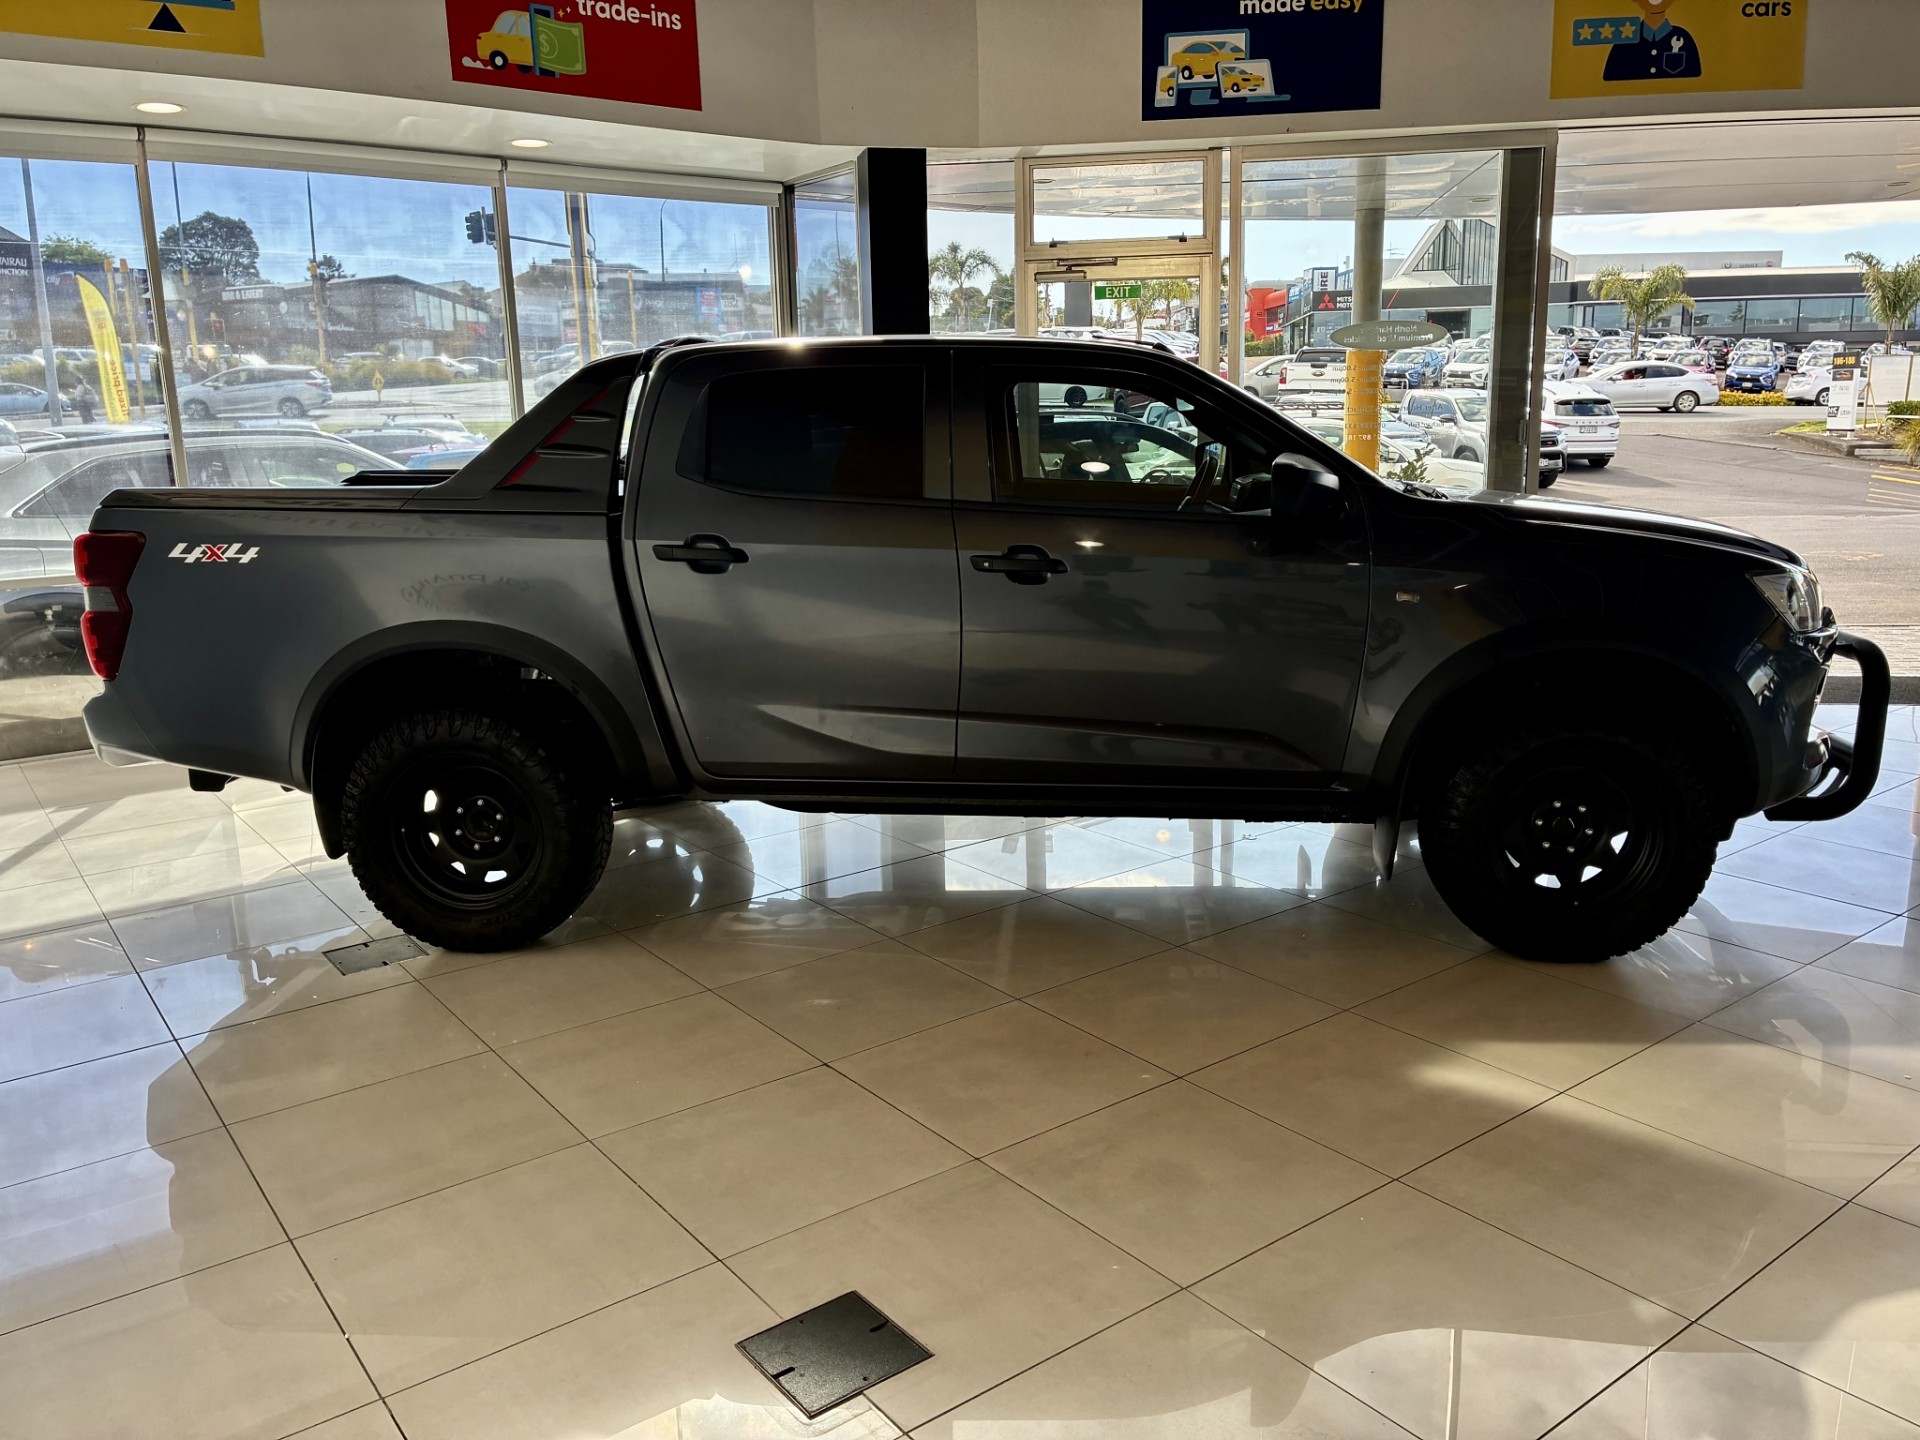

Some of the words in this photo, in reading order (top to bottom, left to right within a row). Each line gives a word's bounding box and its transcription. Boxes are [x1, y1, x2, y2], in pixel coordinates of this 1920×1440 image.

[576, 0, 682, 31] trade-ins
[1239, 0, 1305, 15] made
[1310, 0, 1363, 13] easy
[1741, 1, 1792, 18] cars
[1105, 286, 1131, 298] EXIT
